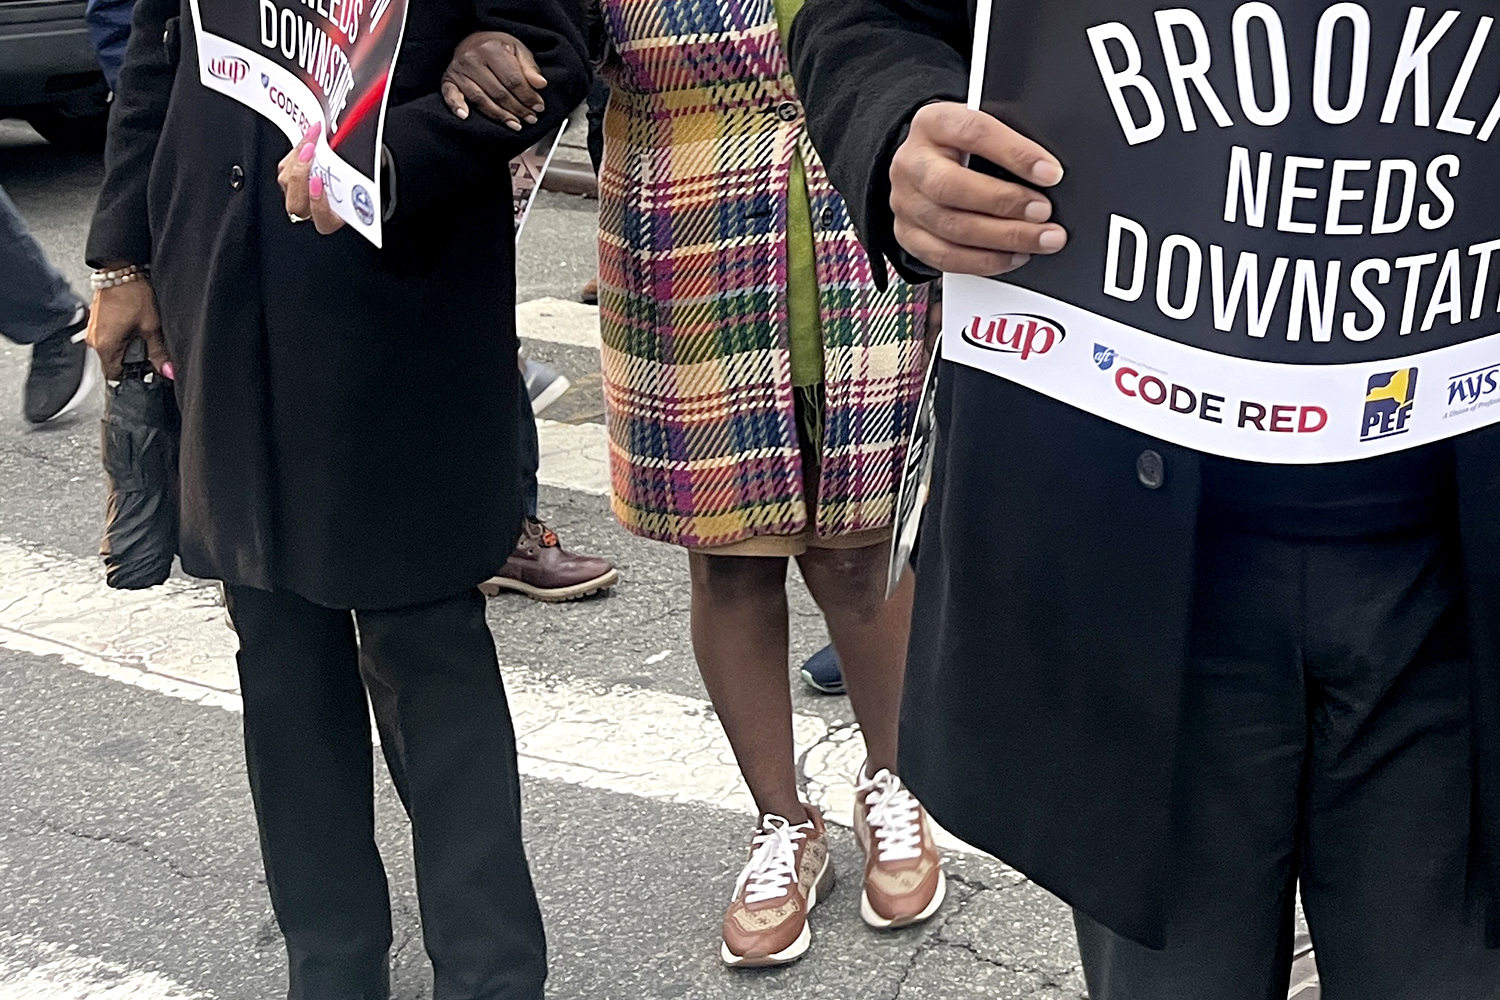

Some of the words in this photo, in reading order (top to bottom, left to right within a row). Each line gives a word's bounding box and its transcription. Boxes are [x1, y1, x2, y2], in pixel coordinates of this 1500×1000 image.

[269, 86, 299, 123] CODE
[1223, 146, 1461, 235] NEEDS
[968, 314, 1058, 360] uup
[1114, 367, 1225, 424] CODE
[1237, 400, 1328, 433] RED
[1361, 407, 1412, 437] PEF
